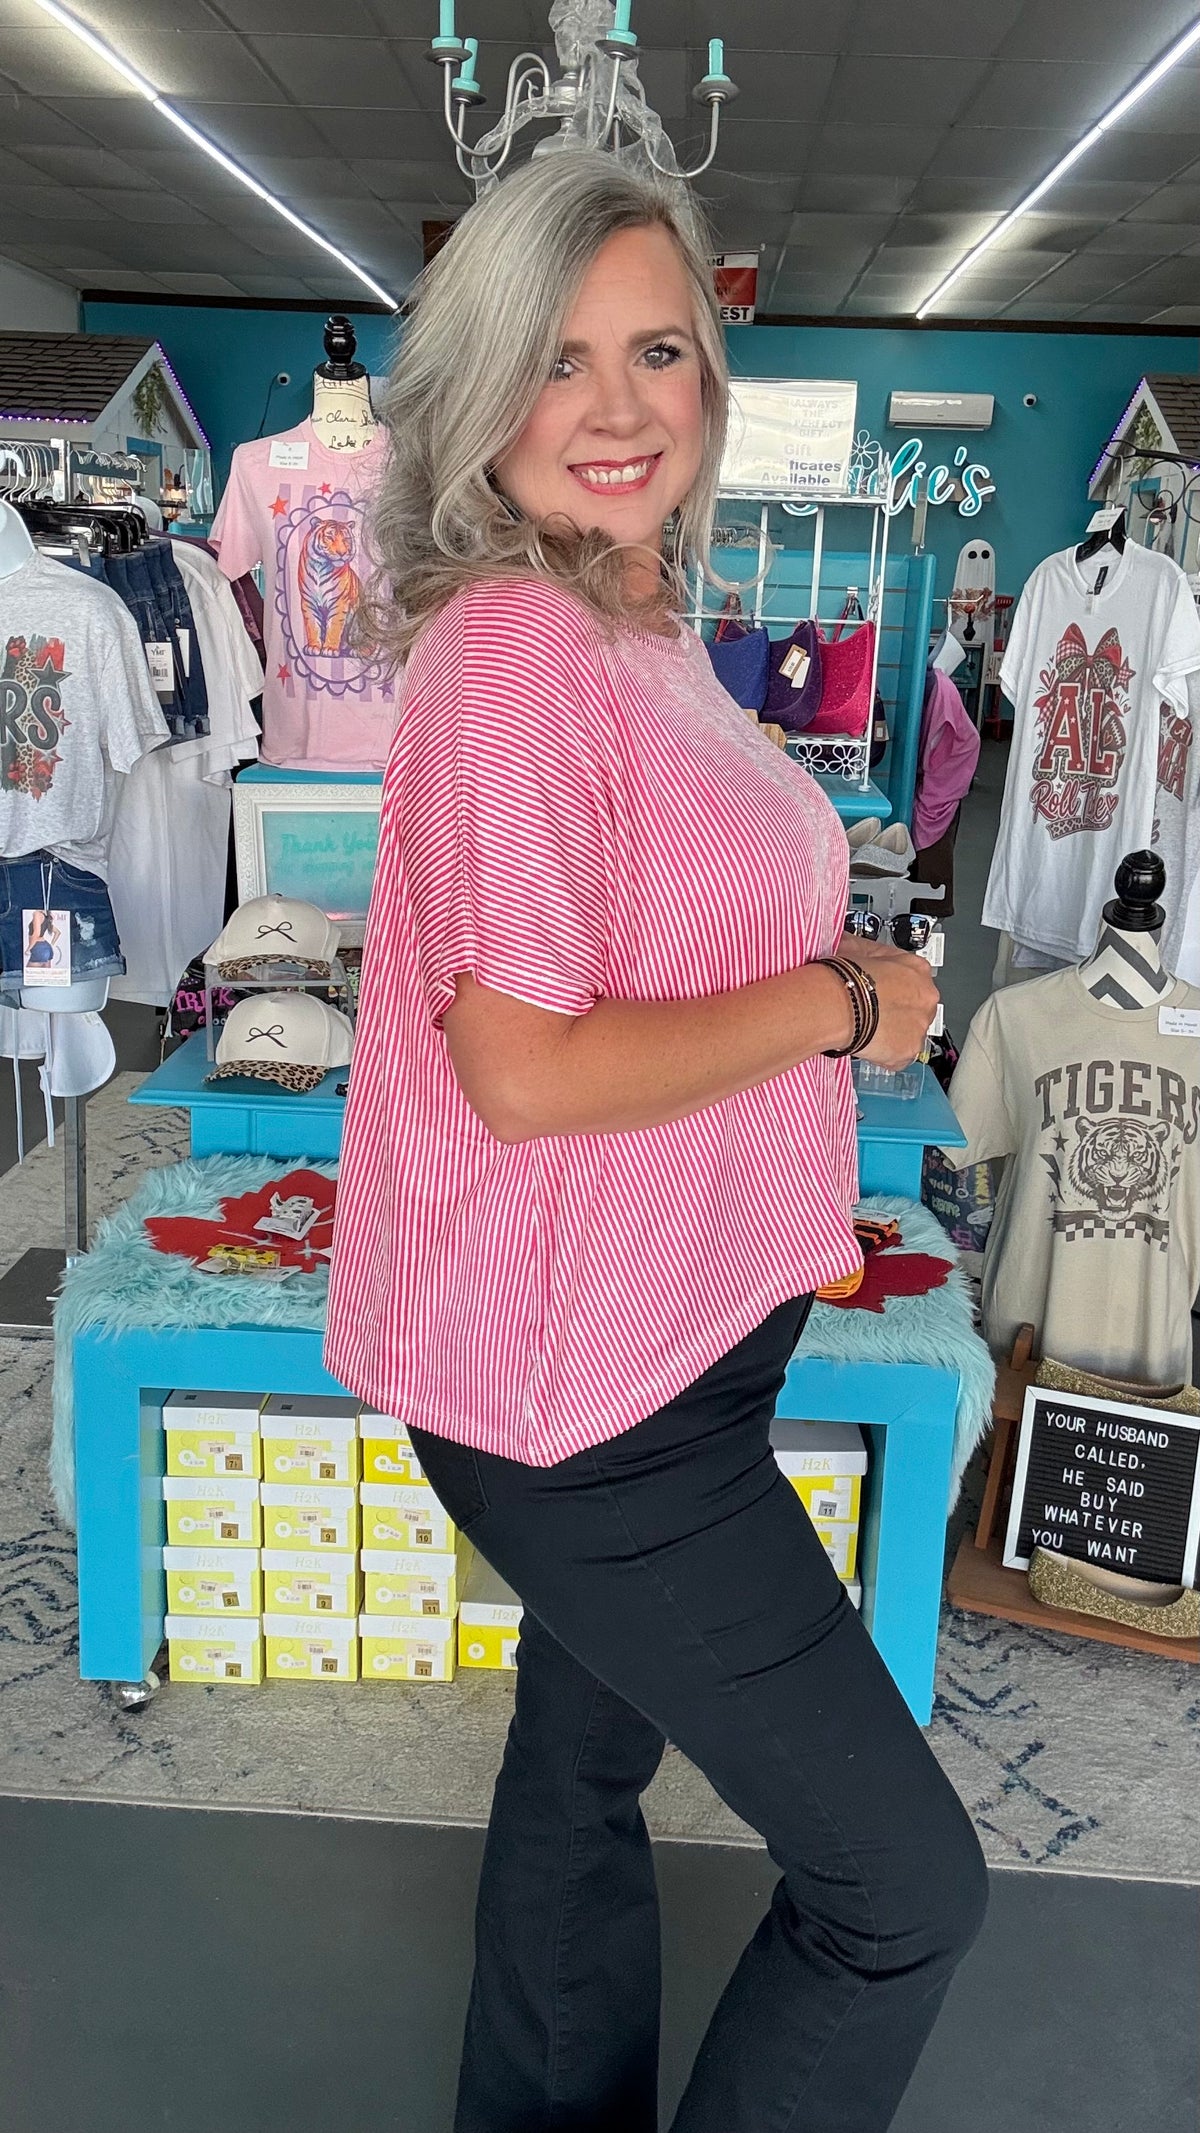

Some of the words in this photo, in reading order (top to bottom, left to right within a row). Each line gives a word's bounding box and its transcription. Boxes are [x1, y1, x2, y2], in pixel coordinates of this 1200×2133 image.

[720, 306, 750, 321] EST
[784, 443, 812, 456] Gift
[1038, 681, 1118, 780] AL
[1029, 779, 1080, 825] Roll
[1034, 1059, 1200, 1145] TIGERS
[294, 1424, 322, 1436] H2K
[1045, 1410, 1087, 1434] YOUR
[1095, 1421, 1169, 1449] HUSBAND
[1074, 1443, 1146, 1470] CALLED,
[801, 1458, 833, 1471] H2K
[1062, 1467, 1085, 1486] HE
[1106, 1476, 1145, 1498] SAID
[294, 1490, 322, 1503] H2K
[393, 1490, 422, 1504] H2K
[1080, 1491, 1118, 1512] BUY
[823, 1507, 834, 1516] 11
[1044, 1504, 1143, 1539] WHATEVER
[418, 1534, 430, 1543] 10
[1031, 1528, 1064, 1549] YOU
[1087, 1539, 1138, 1564] WANT
[294, 1558, 322, 1569] H2K
[394, 1558, 422, 1571] H2K
[491, 1608, 519, 1620] H2K
[294, 1621, 322, 1633] H2K
[391, 1621, 419, 1634] H2K
[324, 1663, 334, 1671] 10
[419, 1668, 429, 1676] 11
